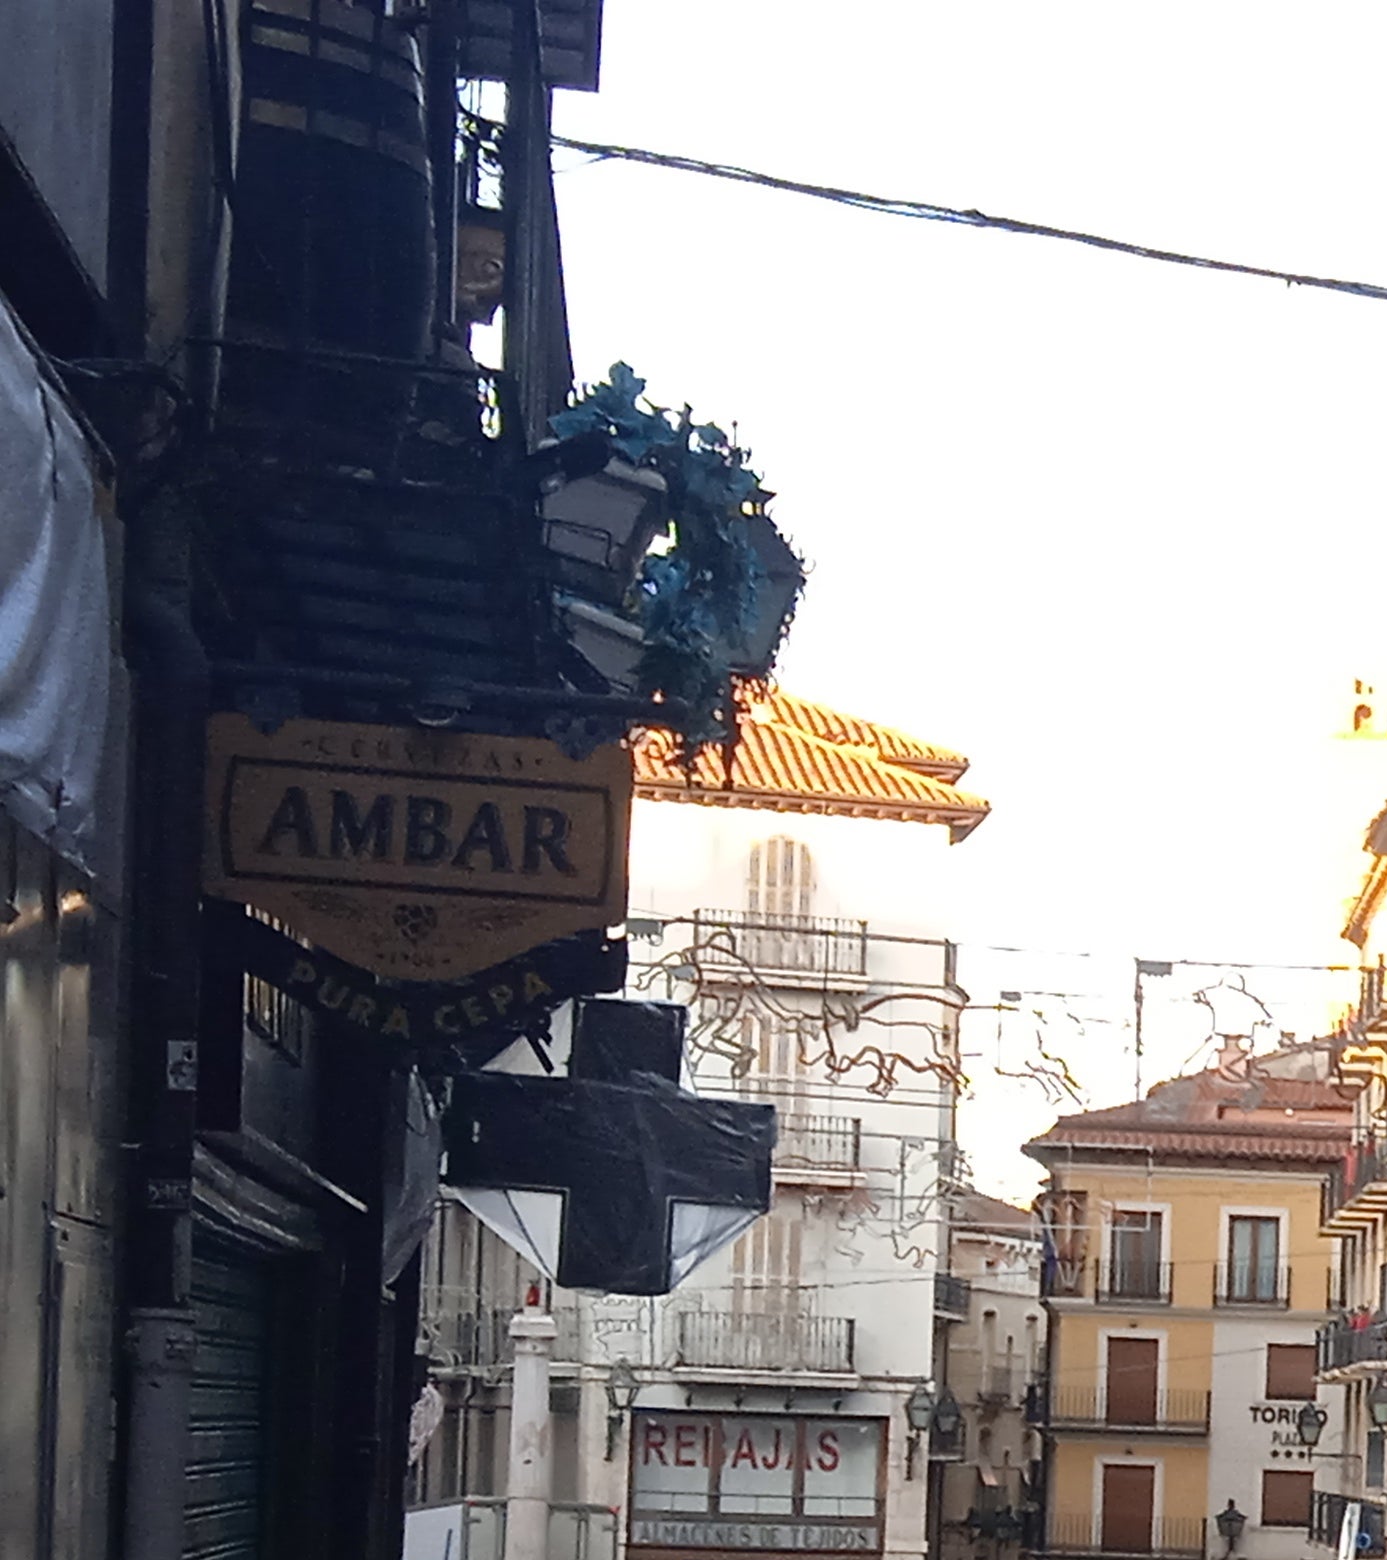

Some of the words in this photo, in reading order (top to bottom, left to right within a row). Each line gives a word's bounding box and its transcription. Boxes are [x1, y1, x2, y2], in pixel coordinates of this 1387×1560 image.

[256, 786, 579, 878] AMBAR
[288, 960, 410, 1039] PURA
[433, 972, 552, 1036] CEPA
[1272, 1430, 1306, 1446] PLAZ
[759, 1526, 781, 1547] DE
